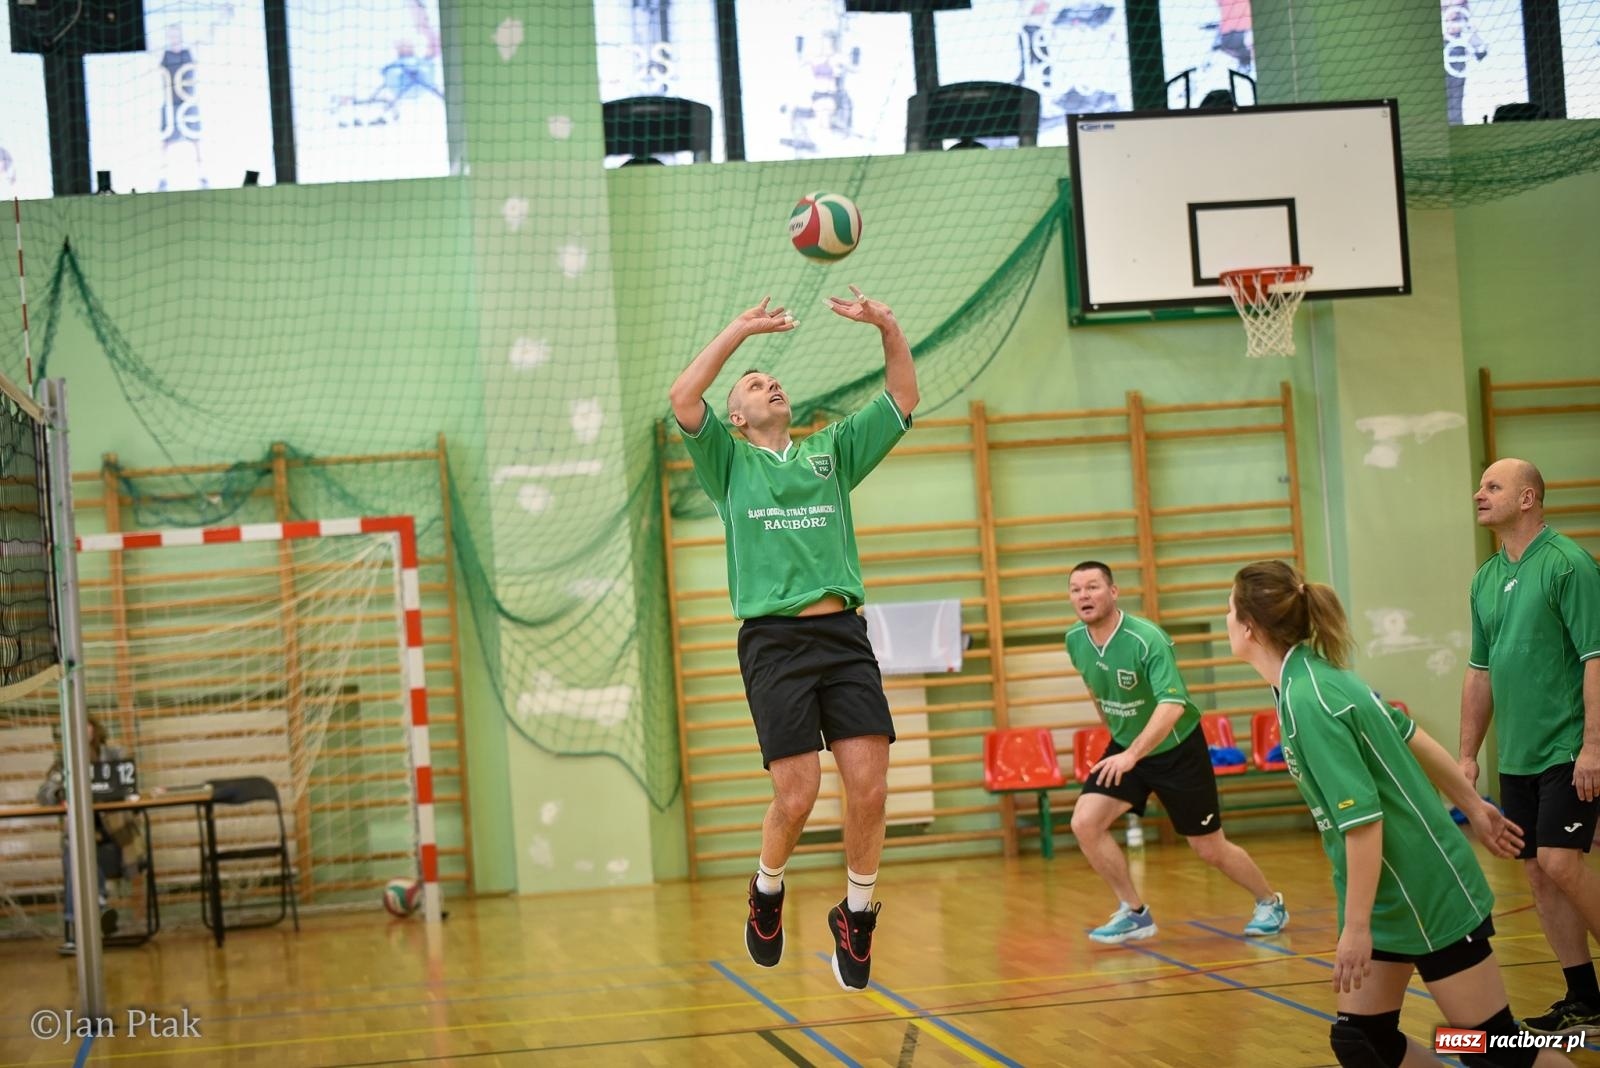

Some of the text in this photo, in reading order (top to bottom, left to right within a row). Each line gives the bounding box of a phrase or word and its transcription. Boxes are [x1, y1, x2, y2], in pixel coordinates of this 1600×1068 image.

[786, 506, 807, 517] STRAŻY
[764, 516, 827, 530] RACIBÓRZ
[116, 762, 135, 785] 12
